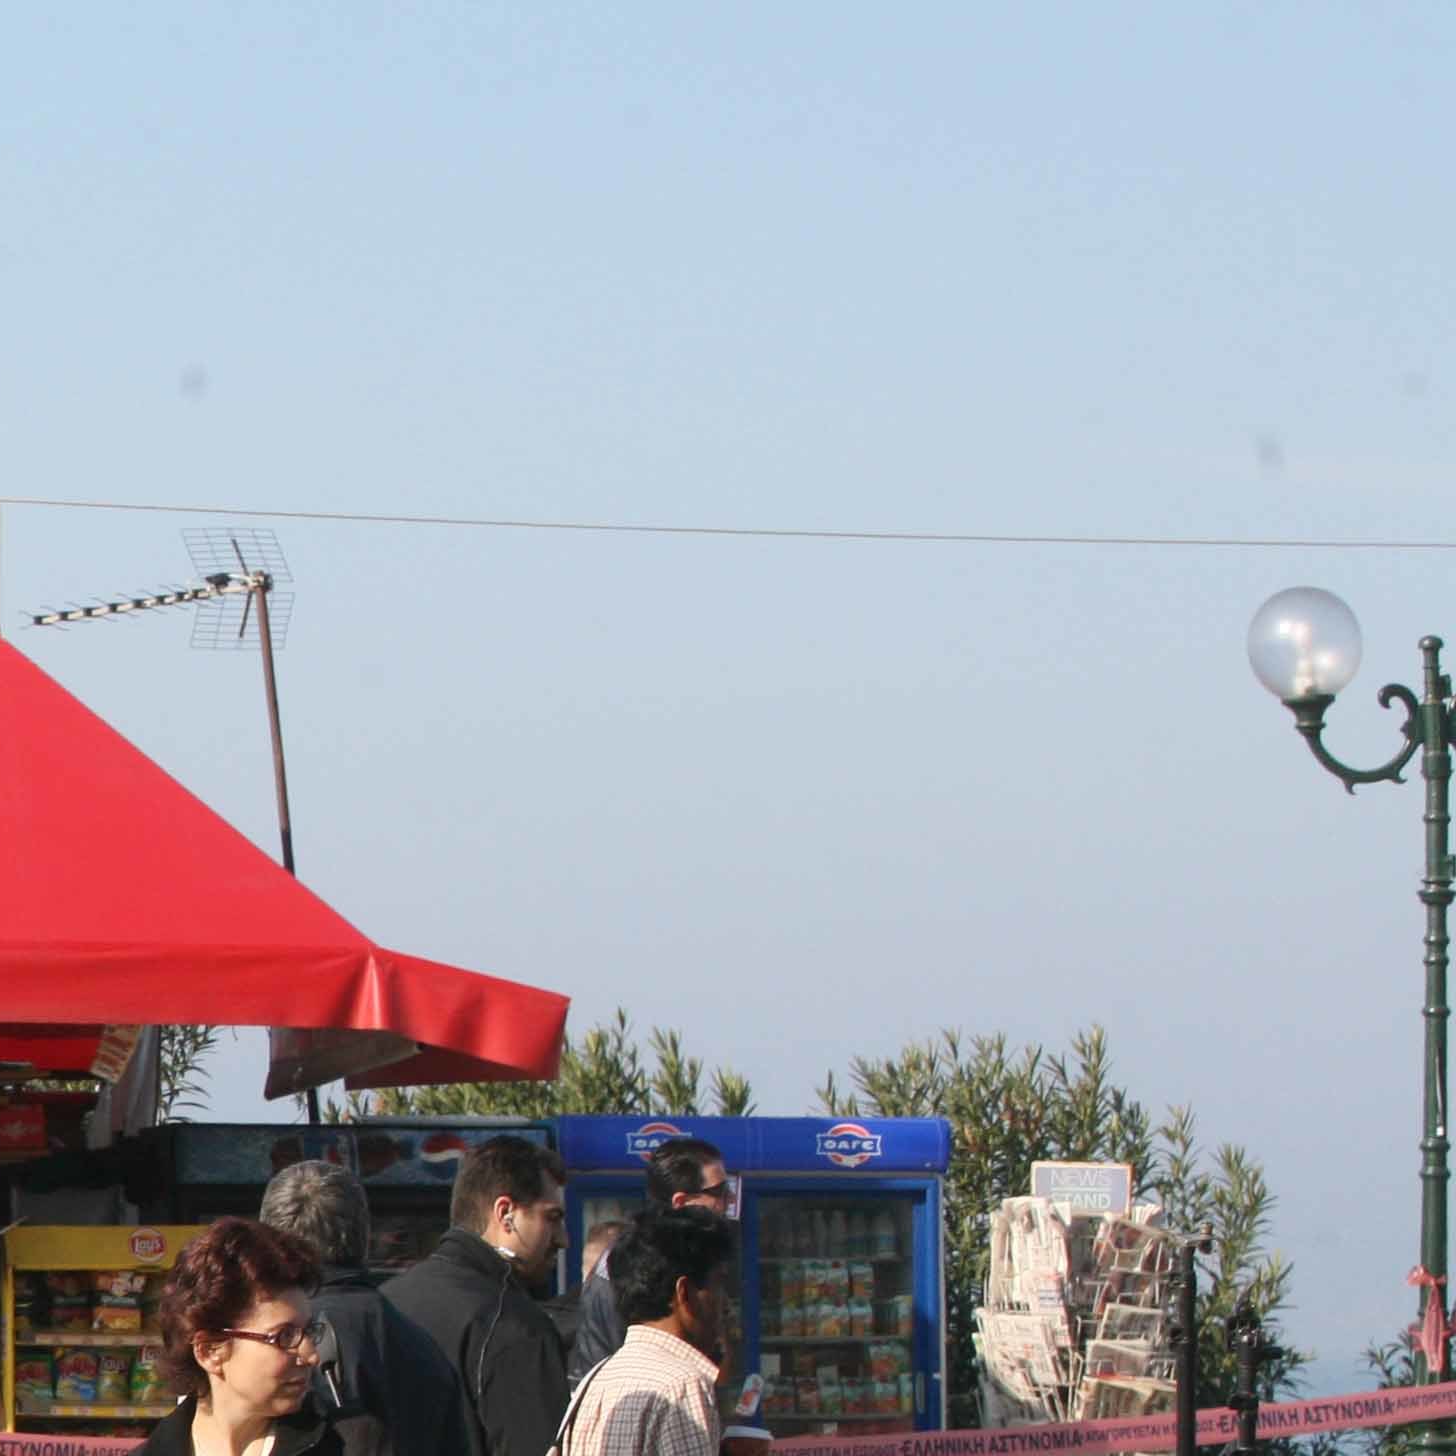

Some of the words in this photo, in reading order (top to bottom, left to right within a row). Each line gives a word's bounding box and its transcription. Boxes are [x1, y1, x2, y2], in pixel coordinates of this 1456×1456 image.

[1050, 1168, 1113, 1187] NEWS
[988, 1429, 1082, 1453] ΑΣΤΥΝΟΜΙΑ
[1303, 1398, 1393, 1426] ΑΣΤΥΝΟΜΙΑ
